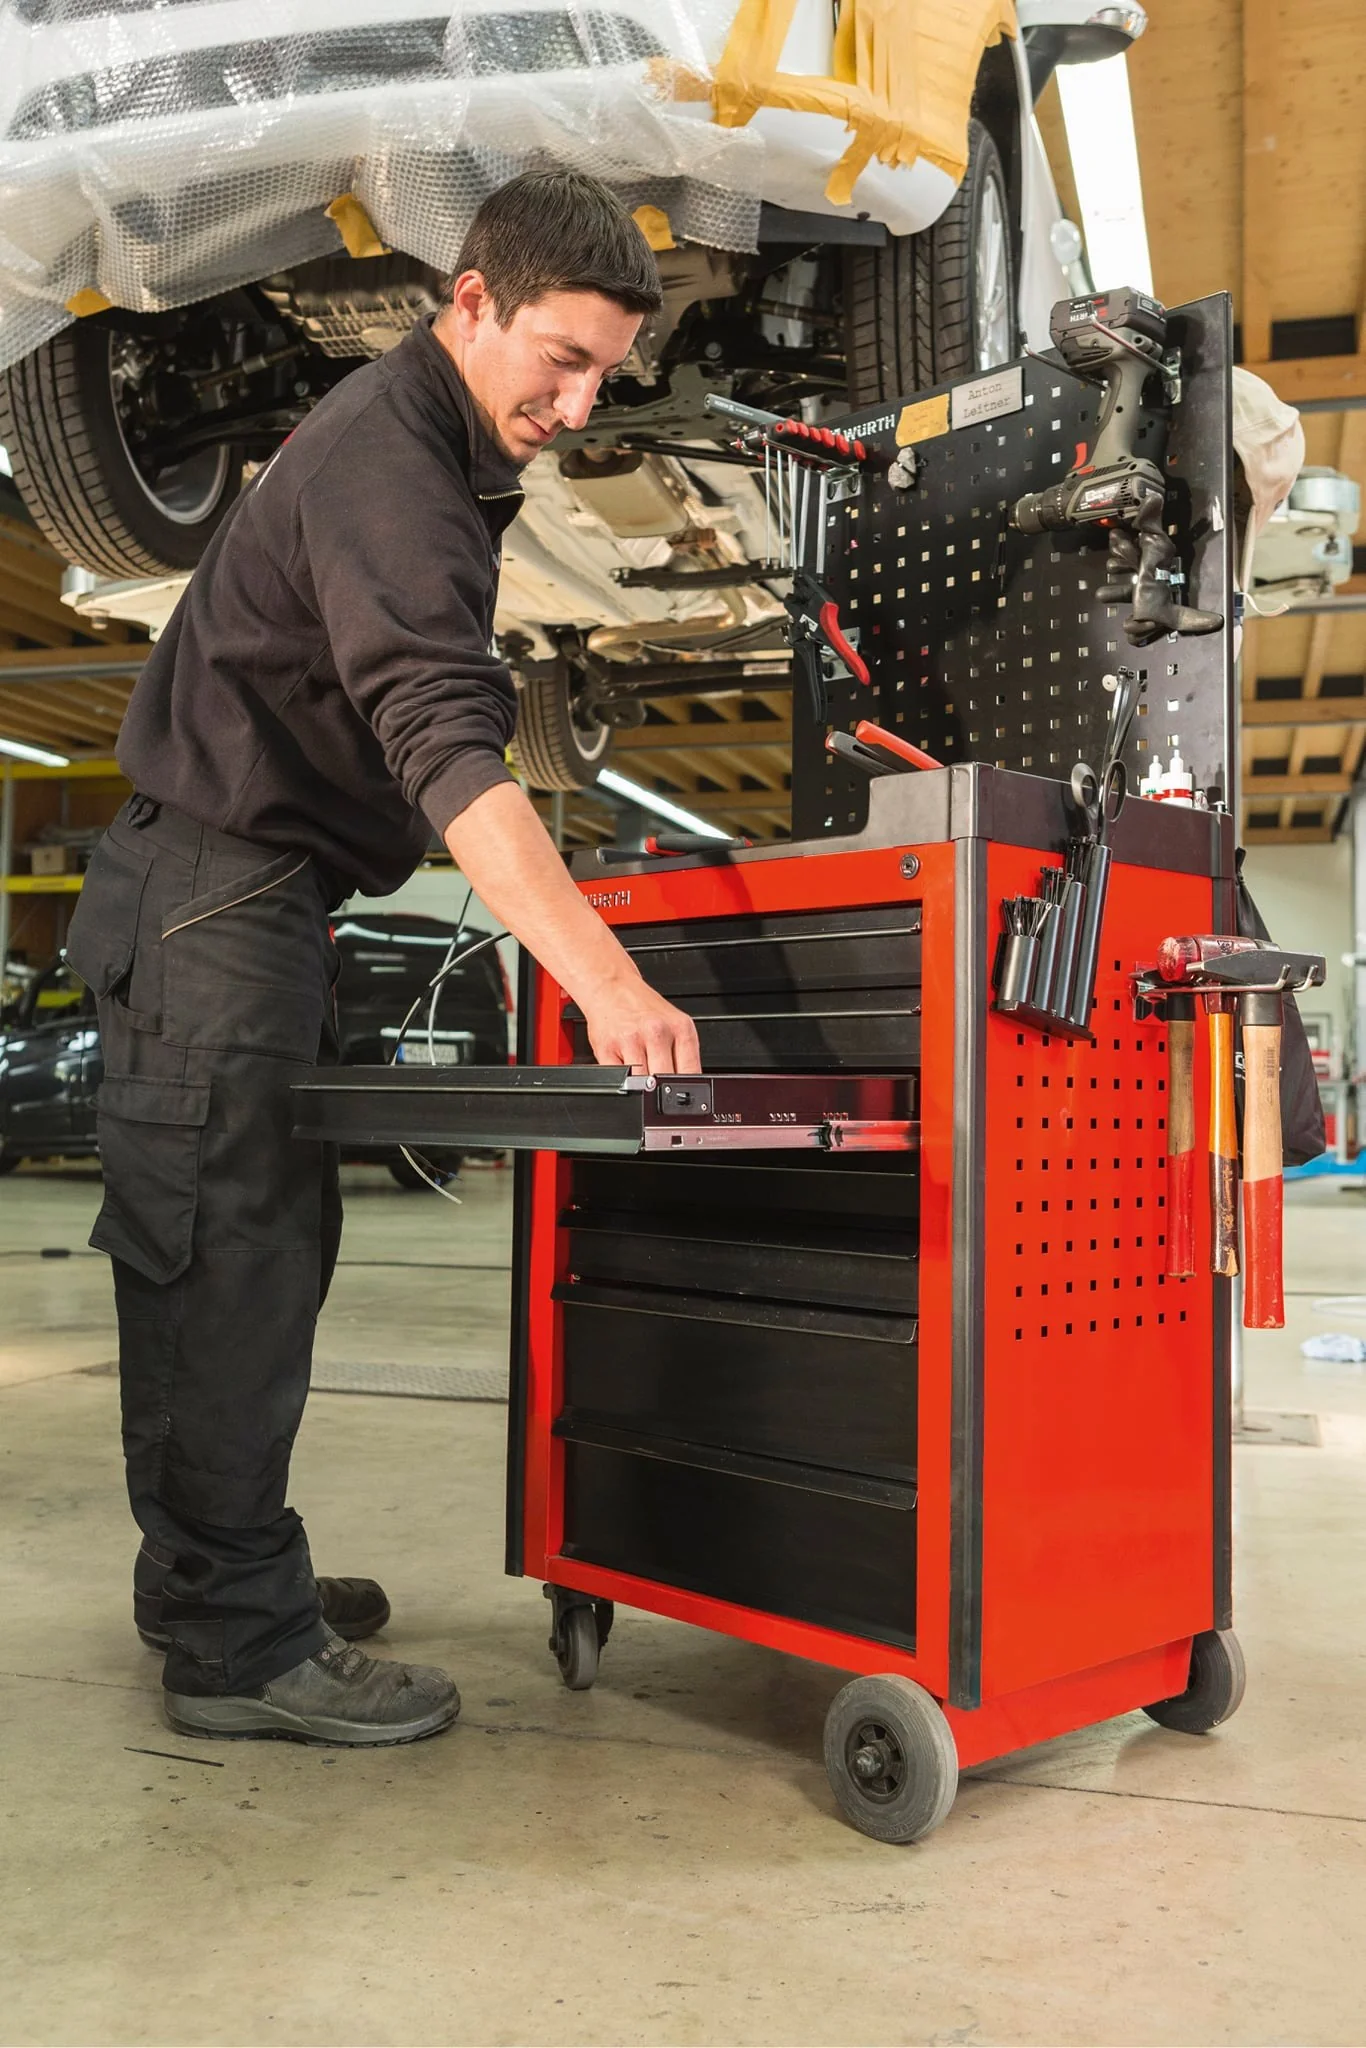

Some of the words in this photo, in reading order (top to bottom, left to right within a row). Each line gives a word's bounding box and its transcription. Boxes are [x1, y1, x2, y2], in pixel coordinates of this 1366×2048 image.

[968, 383, 1003, 401] Anton
[963, 397, 1012, 419] Leitner
[843, 413, 896, 442] WÜRTH
